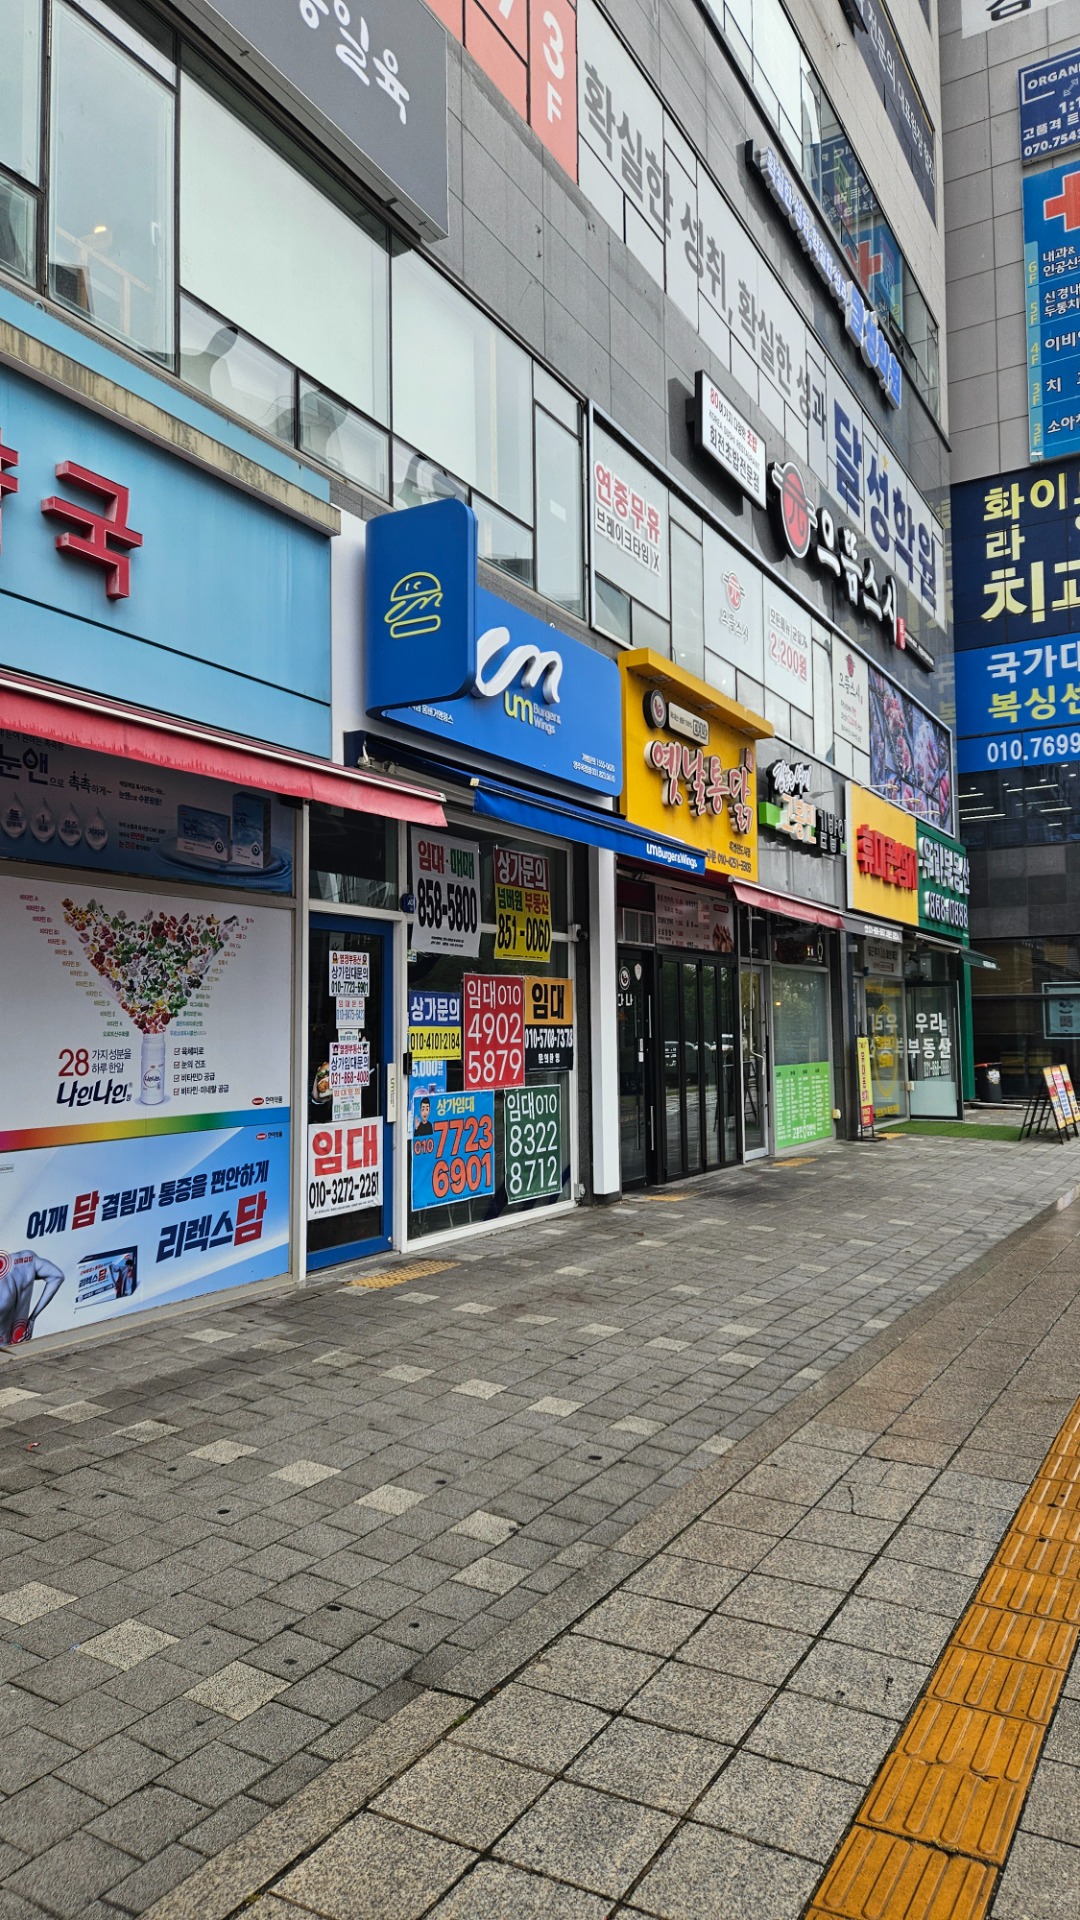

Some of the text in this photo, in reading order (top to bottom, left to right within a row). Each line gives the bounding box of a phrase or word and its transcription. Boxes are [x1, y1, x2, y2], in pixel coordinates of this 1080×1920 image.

[583, 59, 673, 240] 확실한
[738, 279, 792, 398] 확실한
[595, 463, 660, 545] 연중무휴
[833, 397, 938, 612] 달성학원
[983, 471, 1080, 524] 화이
[596, 508, 649, 565] 브레이크타임
[985, 523, 1025, 561] 라
[770, 632, 808, 682] 2,200원
[533, 718, 556, 735] Wings
[987, 730, 1080, 763] 010.7699
[648, 740, 753, 834] 옛날통닭
[497, 850, 547, 891] 상가문의
[417, 877, 478, 934] 858-5800
[497, 886, 549, 916] 넘버원 부동산
[497, 913, 550, 953] 851-0060
[331, 966, 369, 980] 상가임대문의
[339, 954, 362, 966] 열정부동산
[330, 981, 369, 994] 010-7723-6901
[467, 979, 521, 1010] 임대 010
[531, 982, 565, 1020] 임대
[410, 996, 460, 1022] 상가문의
[915, 1012, 944, 1034] 우리
[410, 1031, 461, 1050] 010-4101-2184
[467, 1012, 522, 1045] 4902
[58, 1048, 132, 1077] 28 가지 성분을
[331, 1056, 369, 1071] 상가임대문의
[339, 1043, 362, 1055] 열정부동산
[467, 1048, 523, 1084] 5879
[908, 1037, 951, 1060] 부동산
[91, 1062, 124, 1074] 하루 한알
[56, 1078, 128, 1107] 나인나인
[436, 1096, 475, 1116] 상가임대
[507, 1091, 557, 1123] 임대 010
[312, 1125, 378, 1177] 임대
[414, 1114, 493, 1159] 010 7723
[510, 1120, 558, 1158] 8322
[309, 1171, 379, 1210] 010-3272-2281
[432, 1151, 492, 1198] 6901
[510, 1155, 558, 1195] 8712
[26, 1159, 270, 1240] 어깨 담 결림과 통증을 편안하게
[155, 1190, 267, 1264] 리렉스담
